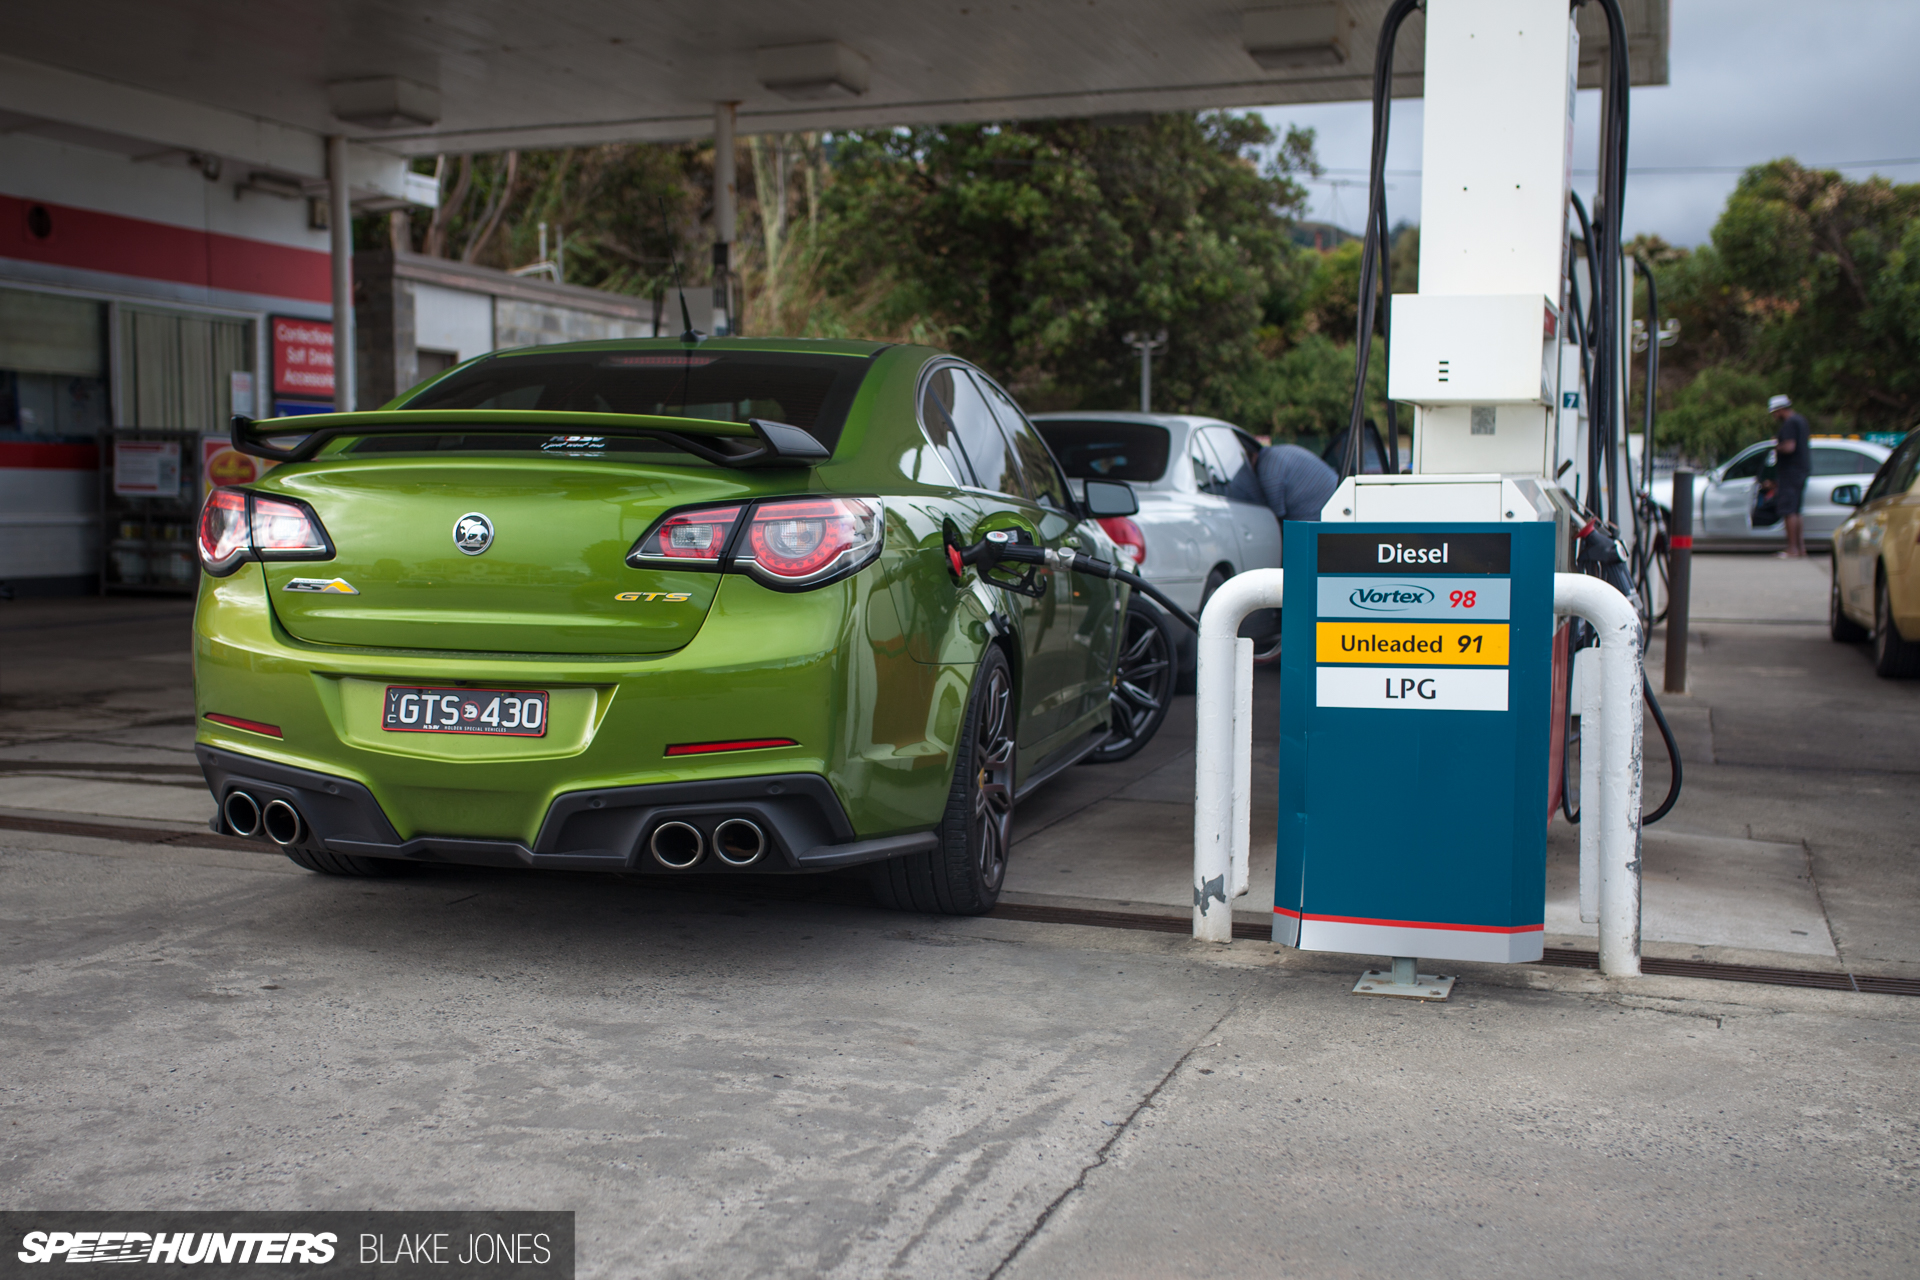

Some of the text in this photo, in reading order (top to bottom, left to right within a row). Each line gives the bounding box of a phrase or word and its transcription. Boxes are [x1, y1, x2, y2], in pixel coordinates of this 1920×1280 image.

[1566, 394, 1577, 409] 7
[1377, 543, 1449, 564] Diesel
[614, 591, 693, 602] GTS
[1354, 587, 1477, 608] Vortex 98
[1341, 634, 1483, 654] Unleaded 91
[1385, 678, 1437, 700] LPG
[387, 693, 399, 723] VIC
[400, 694, 543, 729] GTS 430
